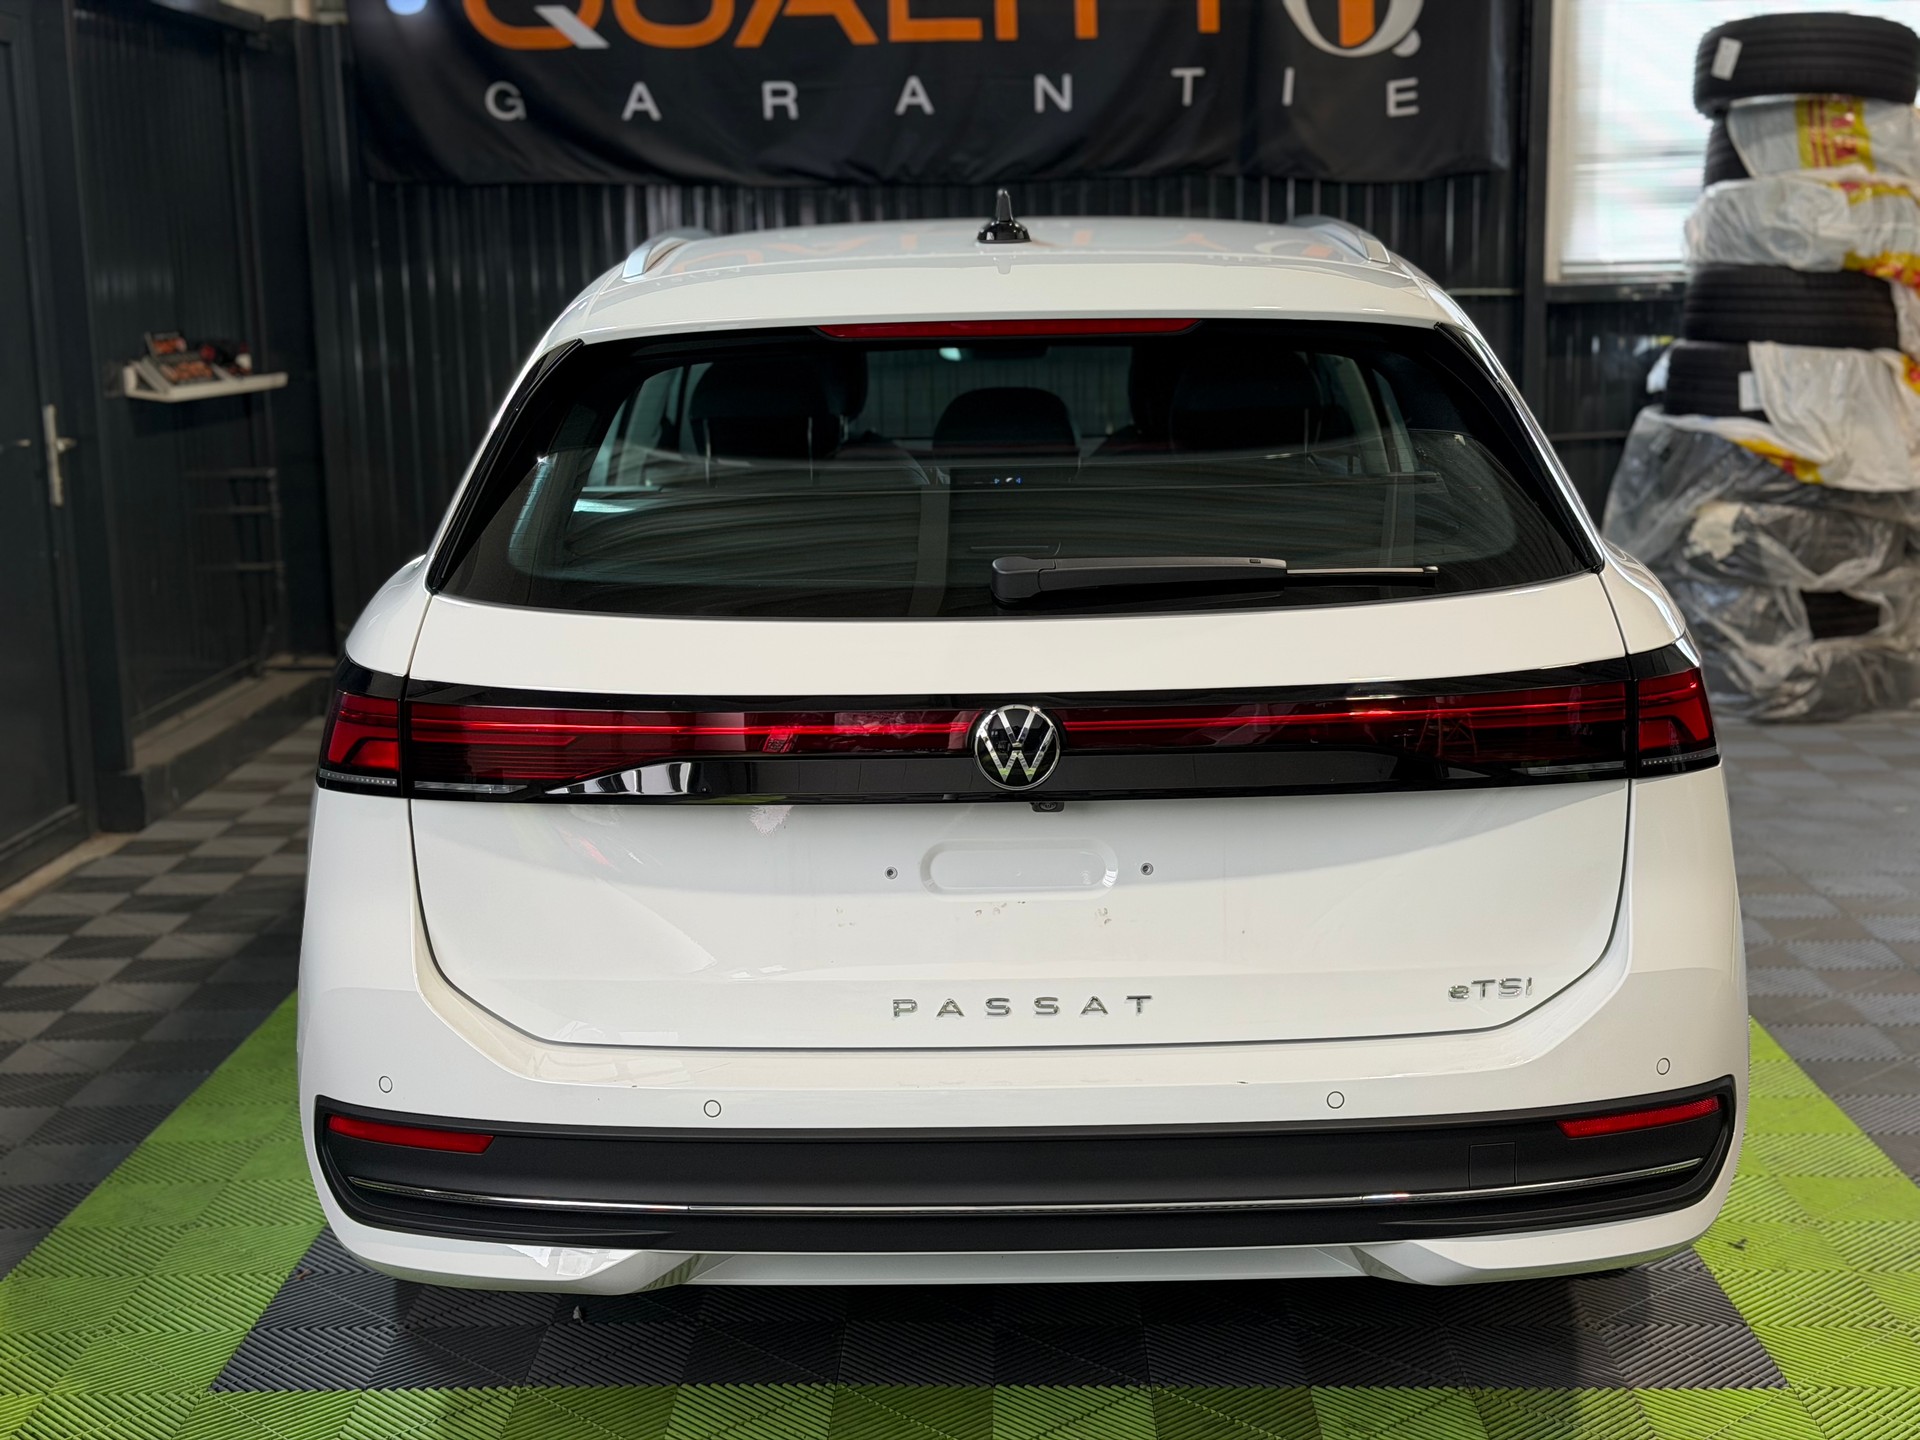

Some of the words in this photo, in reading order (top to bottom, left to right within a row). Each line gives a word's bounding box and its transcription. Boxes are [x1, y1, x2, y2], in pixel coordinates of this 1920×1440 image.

[484, 66, 1421, 122] GARANTIE
[1448, 977, 1532, 1000] eTSI
[892, 994, 1153, 1018] PASSAT
